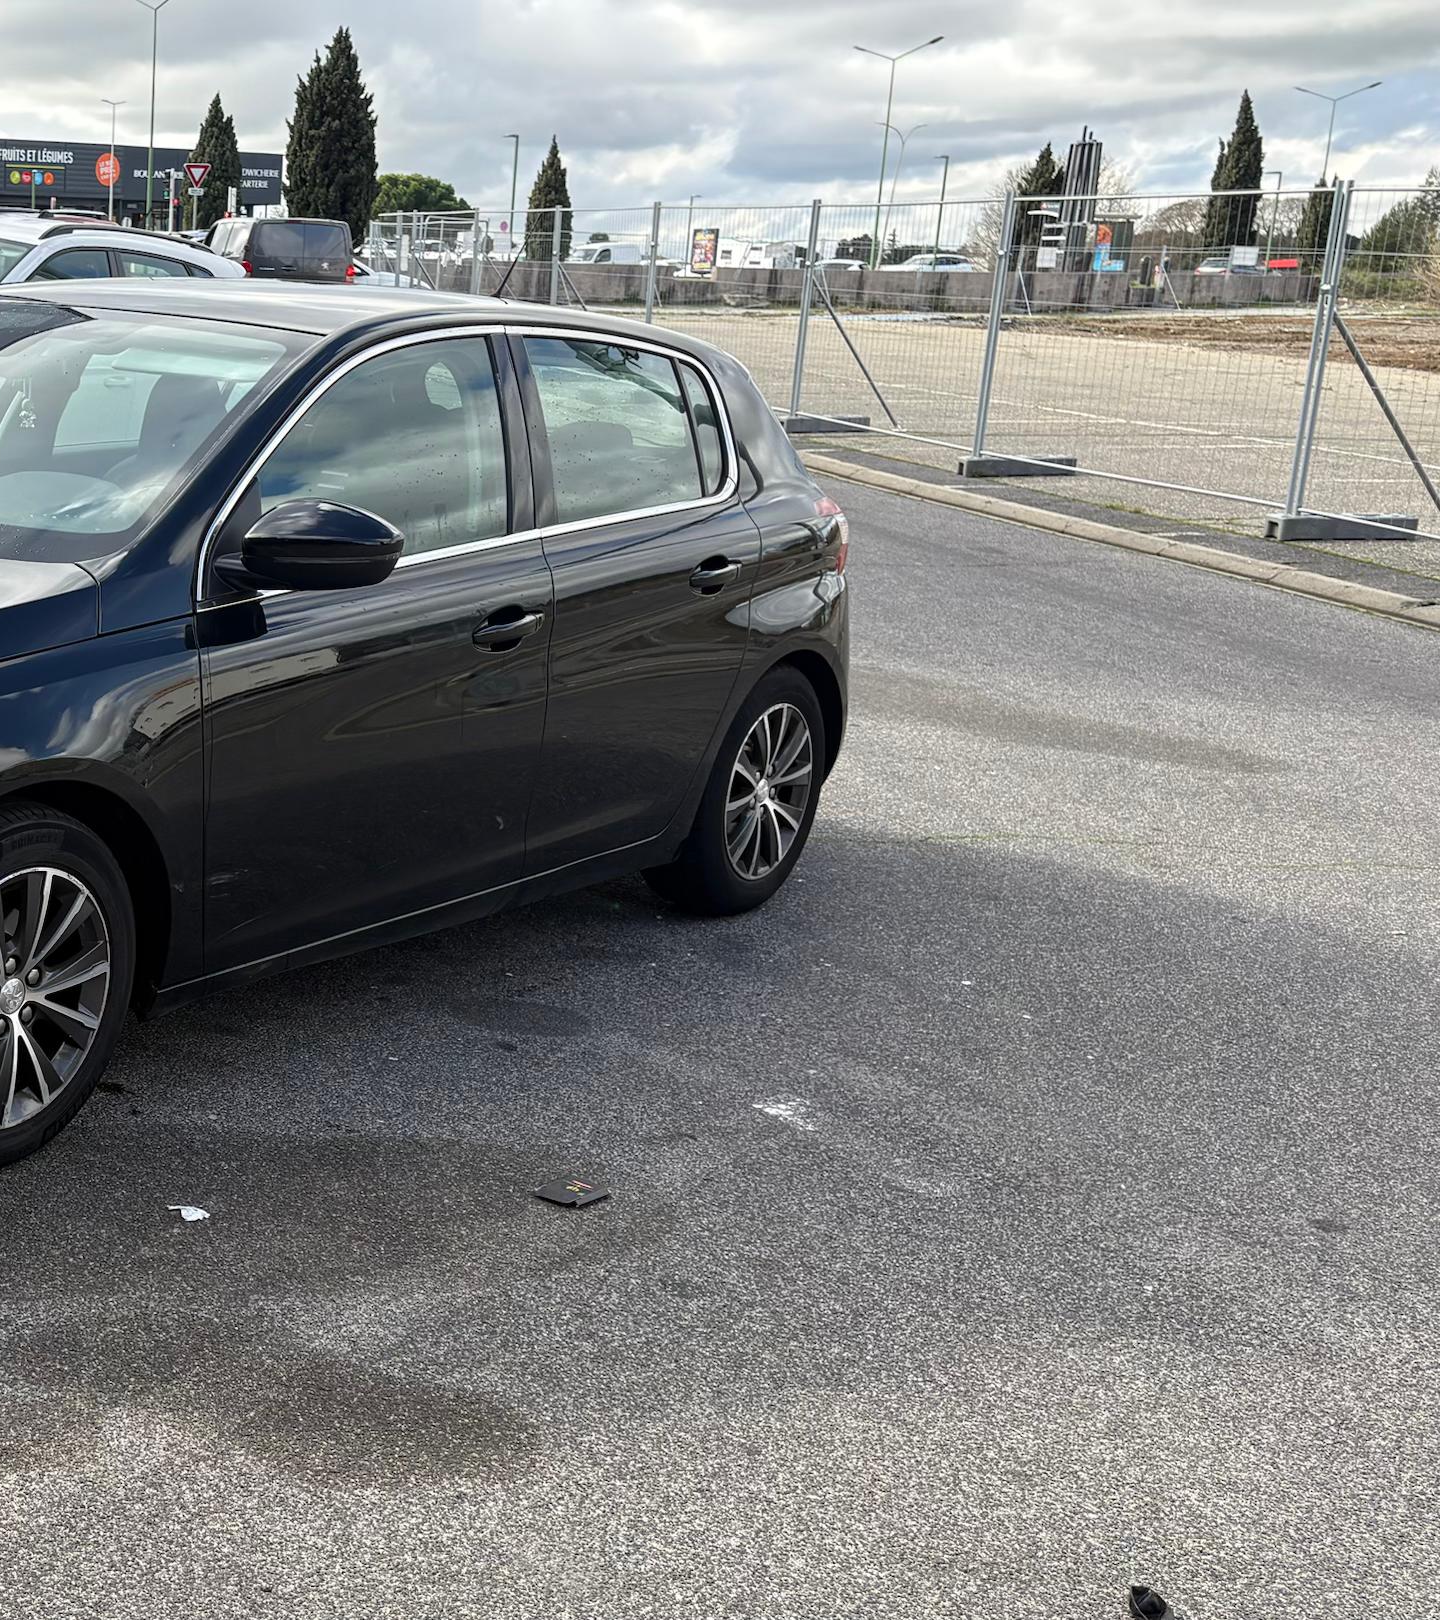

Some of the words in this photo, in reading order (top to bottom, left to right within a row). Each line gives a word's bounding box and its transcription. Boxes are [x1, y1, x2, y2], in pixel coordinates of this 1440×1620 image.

[26, 149, 37, 162] ET
[37, 147, 74, 165] LÉGUMES
[241, 168, 279, 178] DWICHERIE
